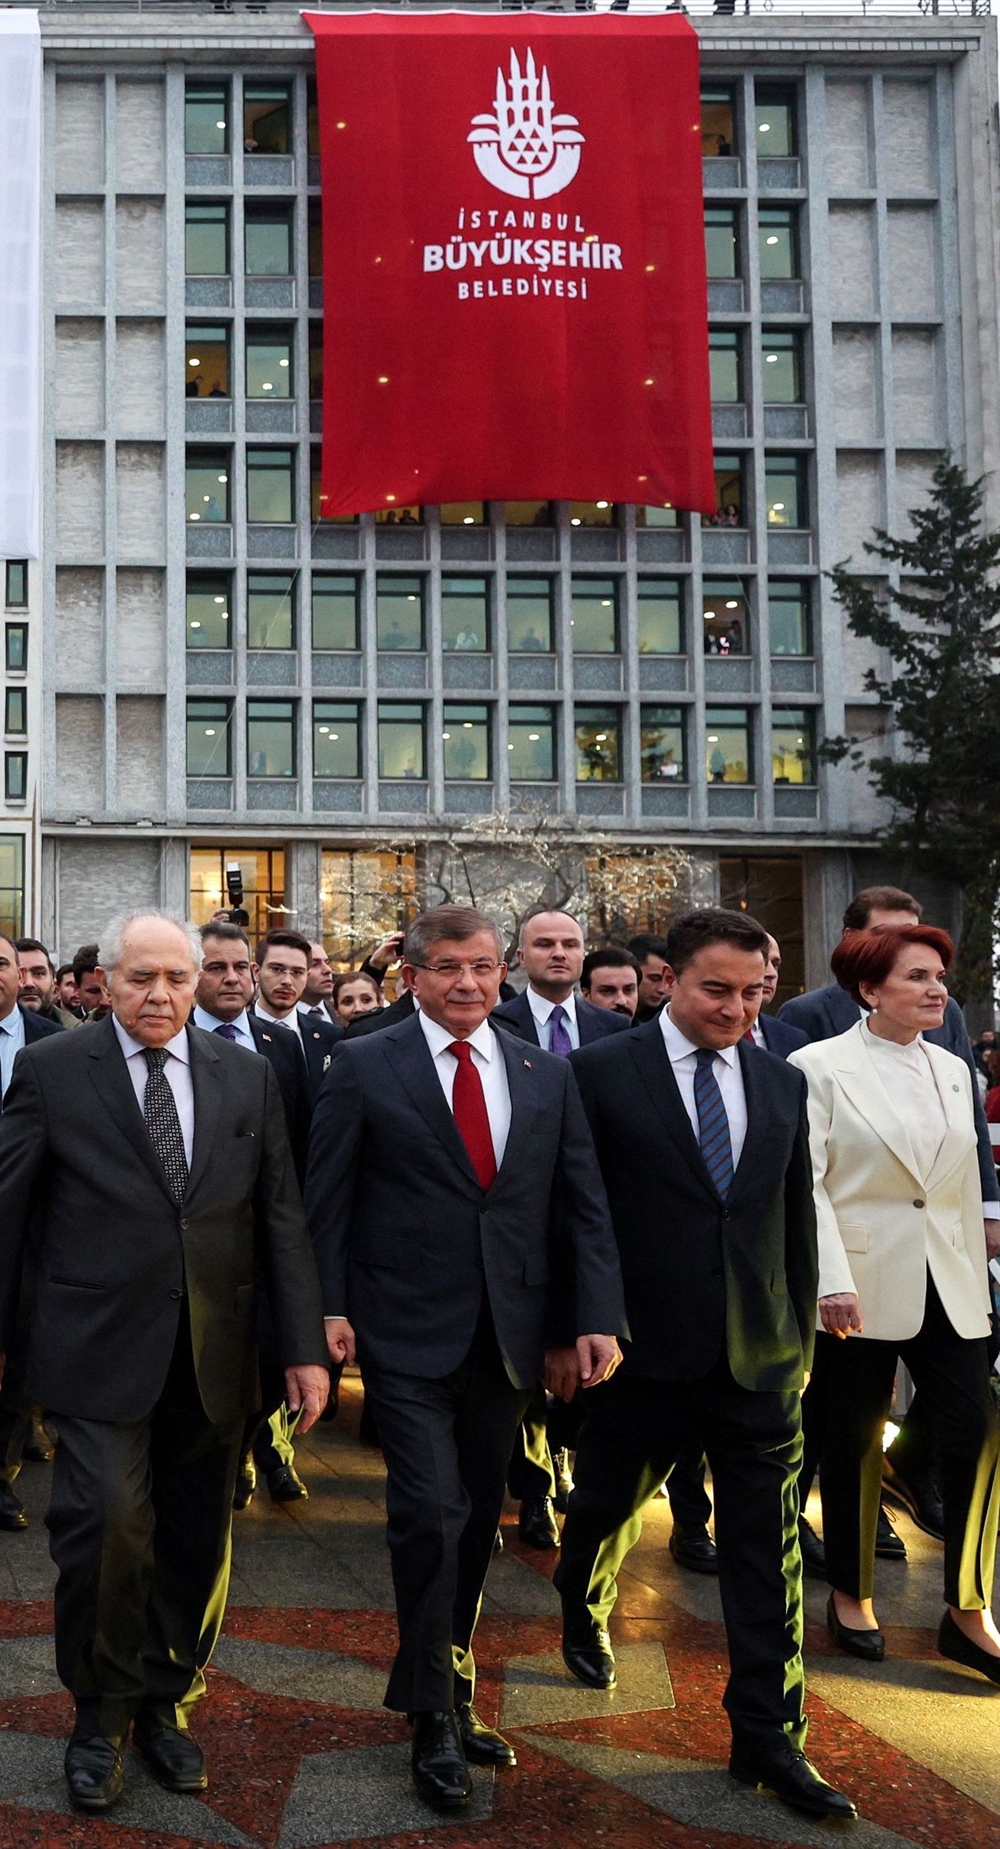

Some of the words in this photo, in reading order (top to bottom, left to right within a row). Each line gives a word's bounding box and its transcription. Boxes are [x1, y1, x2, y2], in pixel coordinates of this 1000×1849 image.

[458, 207, 585, 232] İSTANBUL
[423, 232, 623, 272] BÜYÜKŞEHİR
[458, 274, 587, 300] BELEDİYESİ
